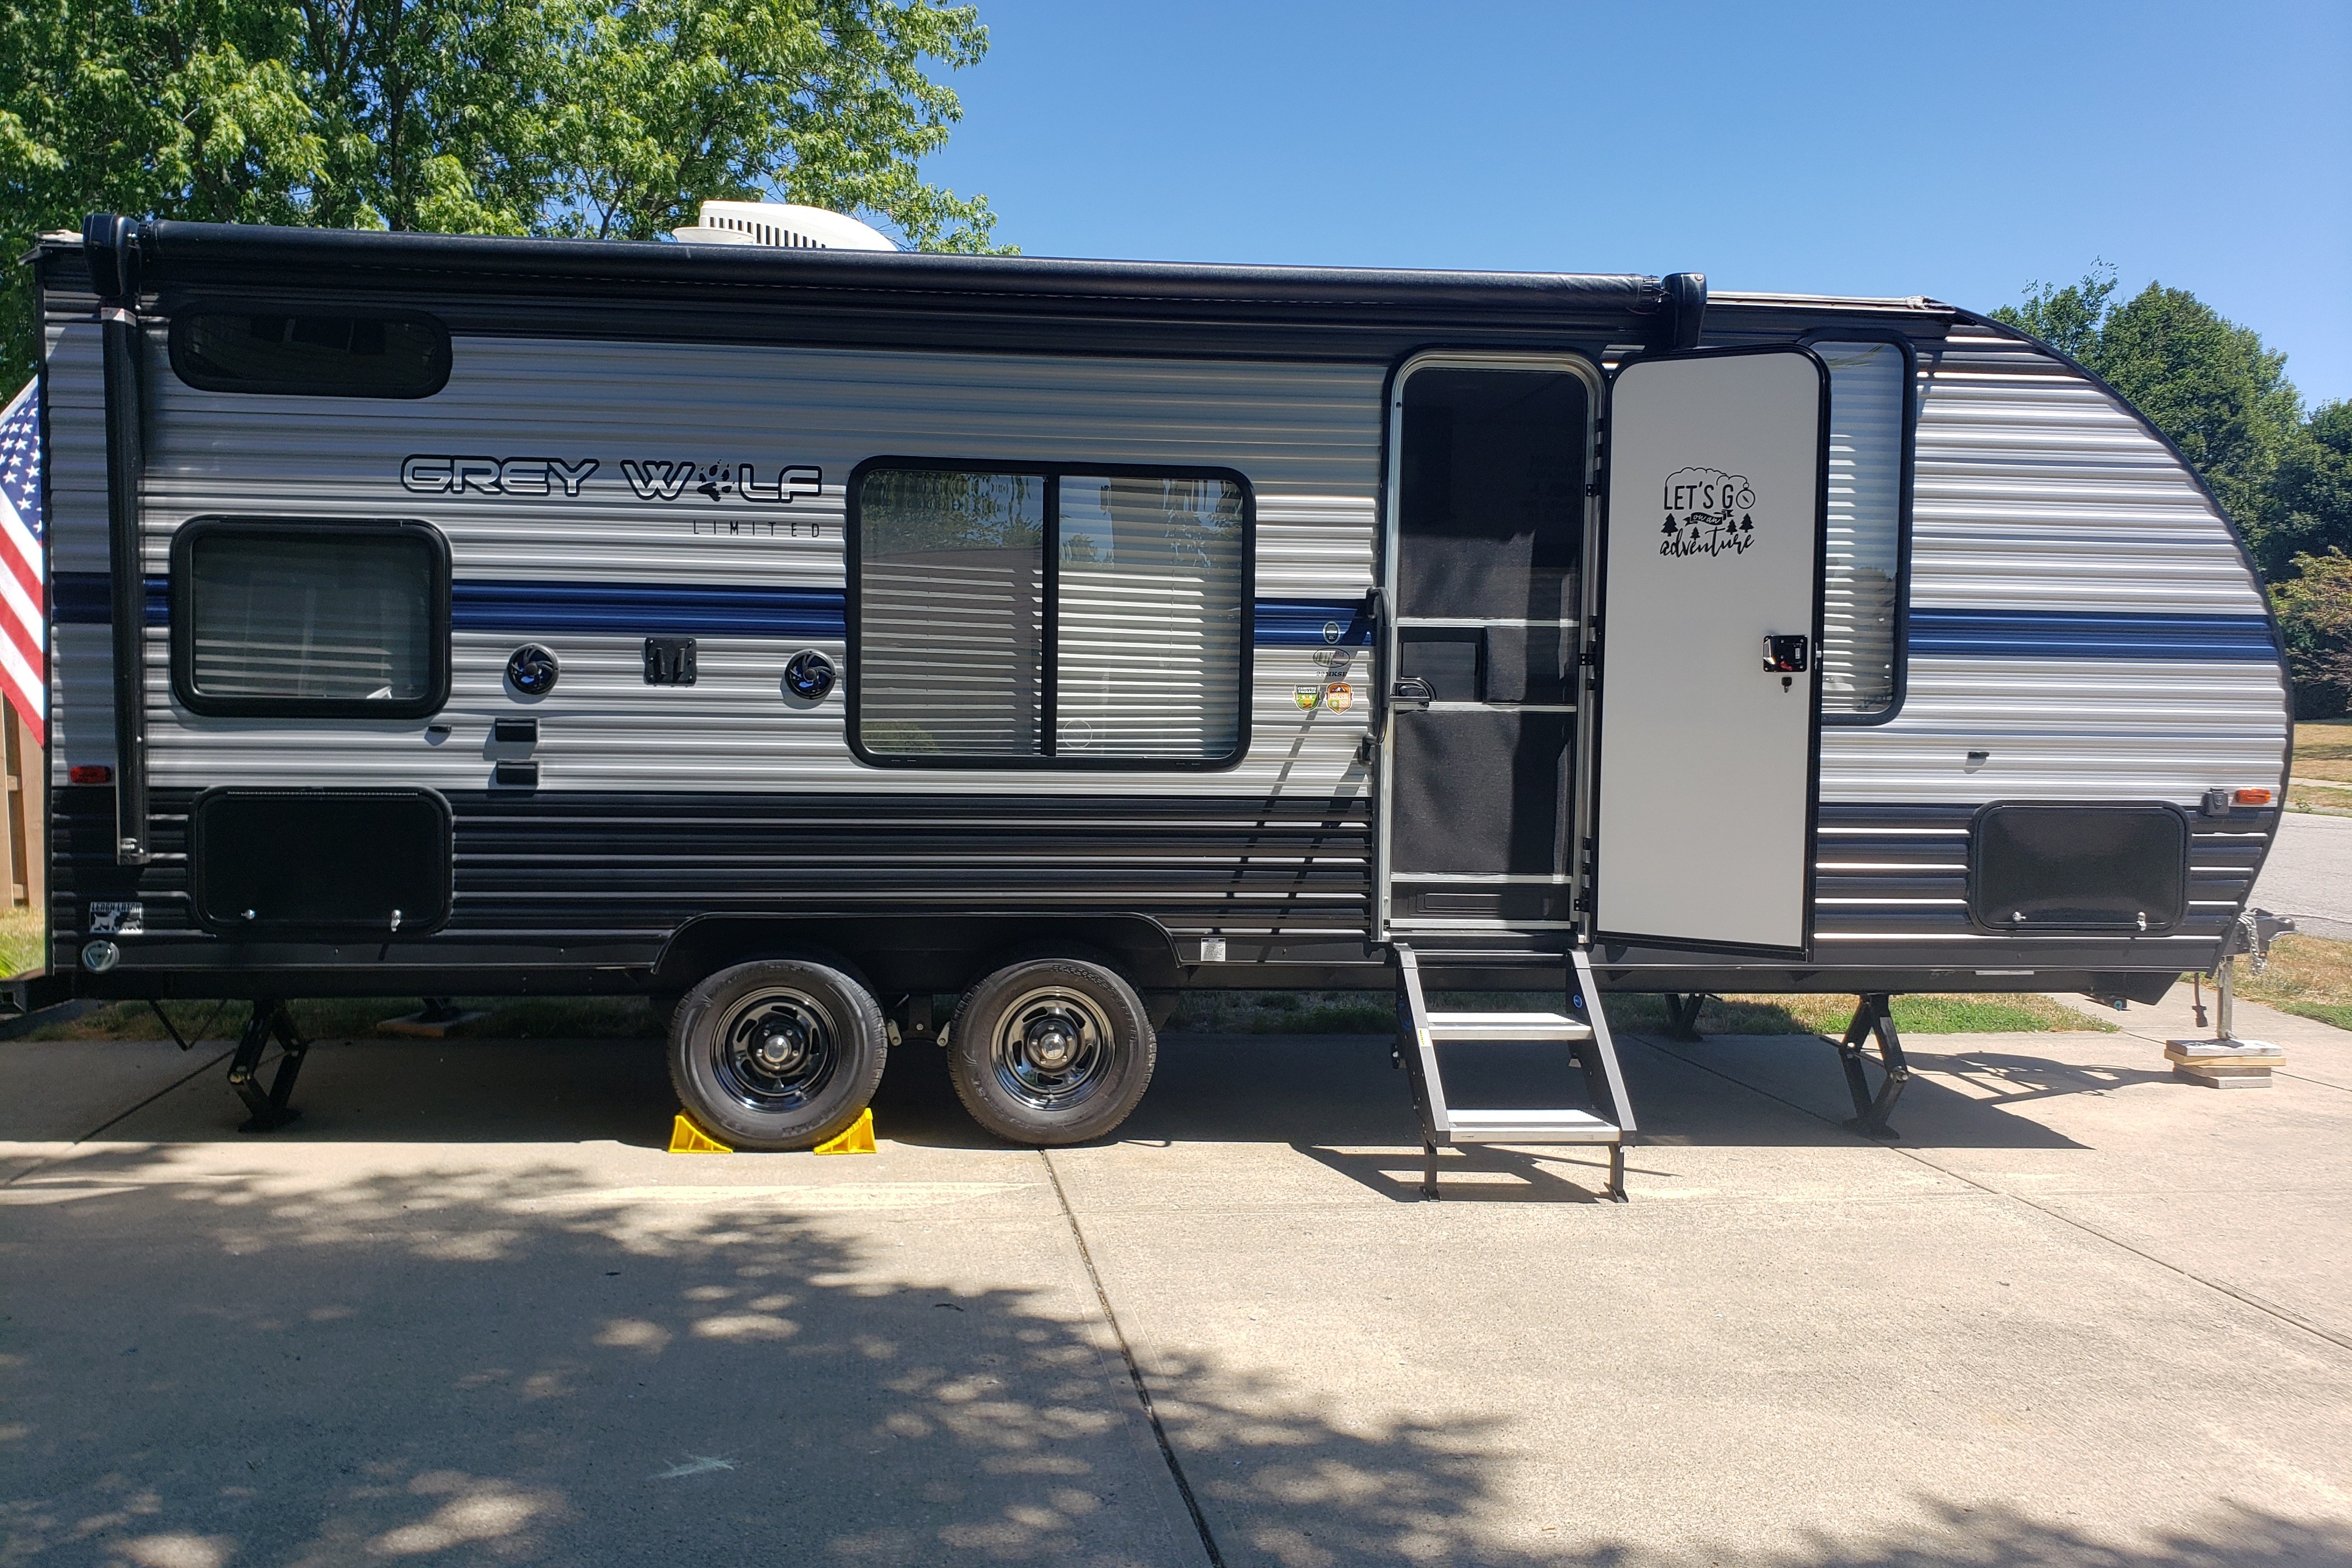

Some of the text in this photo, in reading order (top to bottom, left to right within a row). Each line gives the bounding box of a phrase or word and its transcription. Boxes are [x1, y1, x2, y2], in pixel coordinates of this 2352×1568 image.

[400, 454, 600, 497] GREY
[1664, 481, 1714, 510] LET'S
[692, 519, 820, 538] LIMITED
[1660, 526, 1755, 558] adventure
